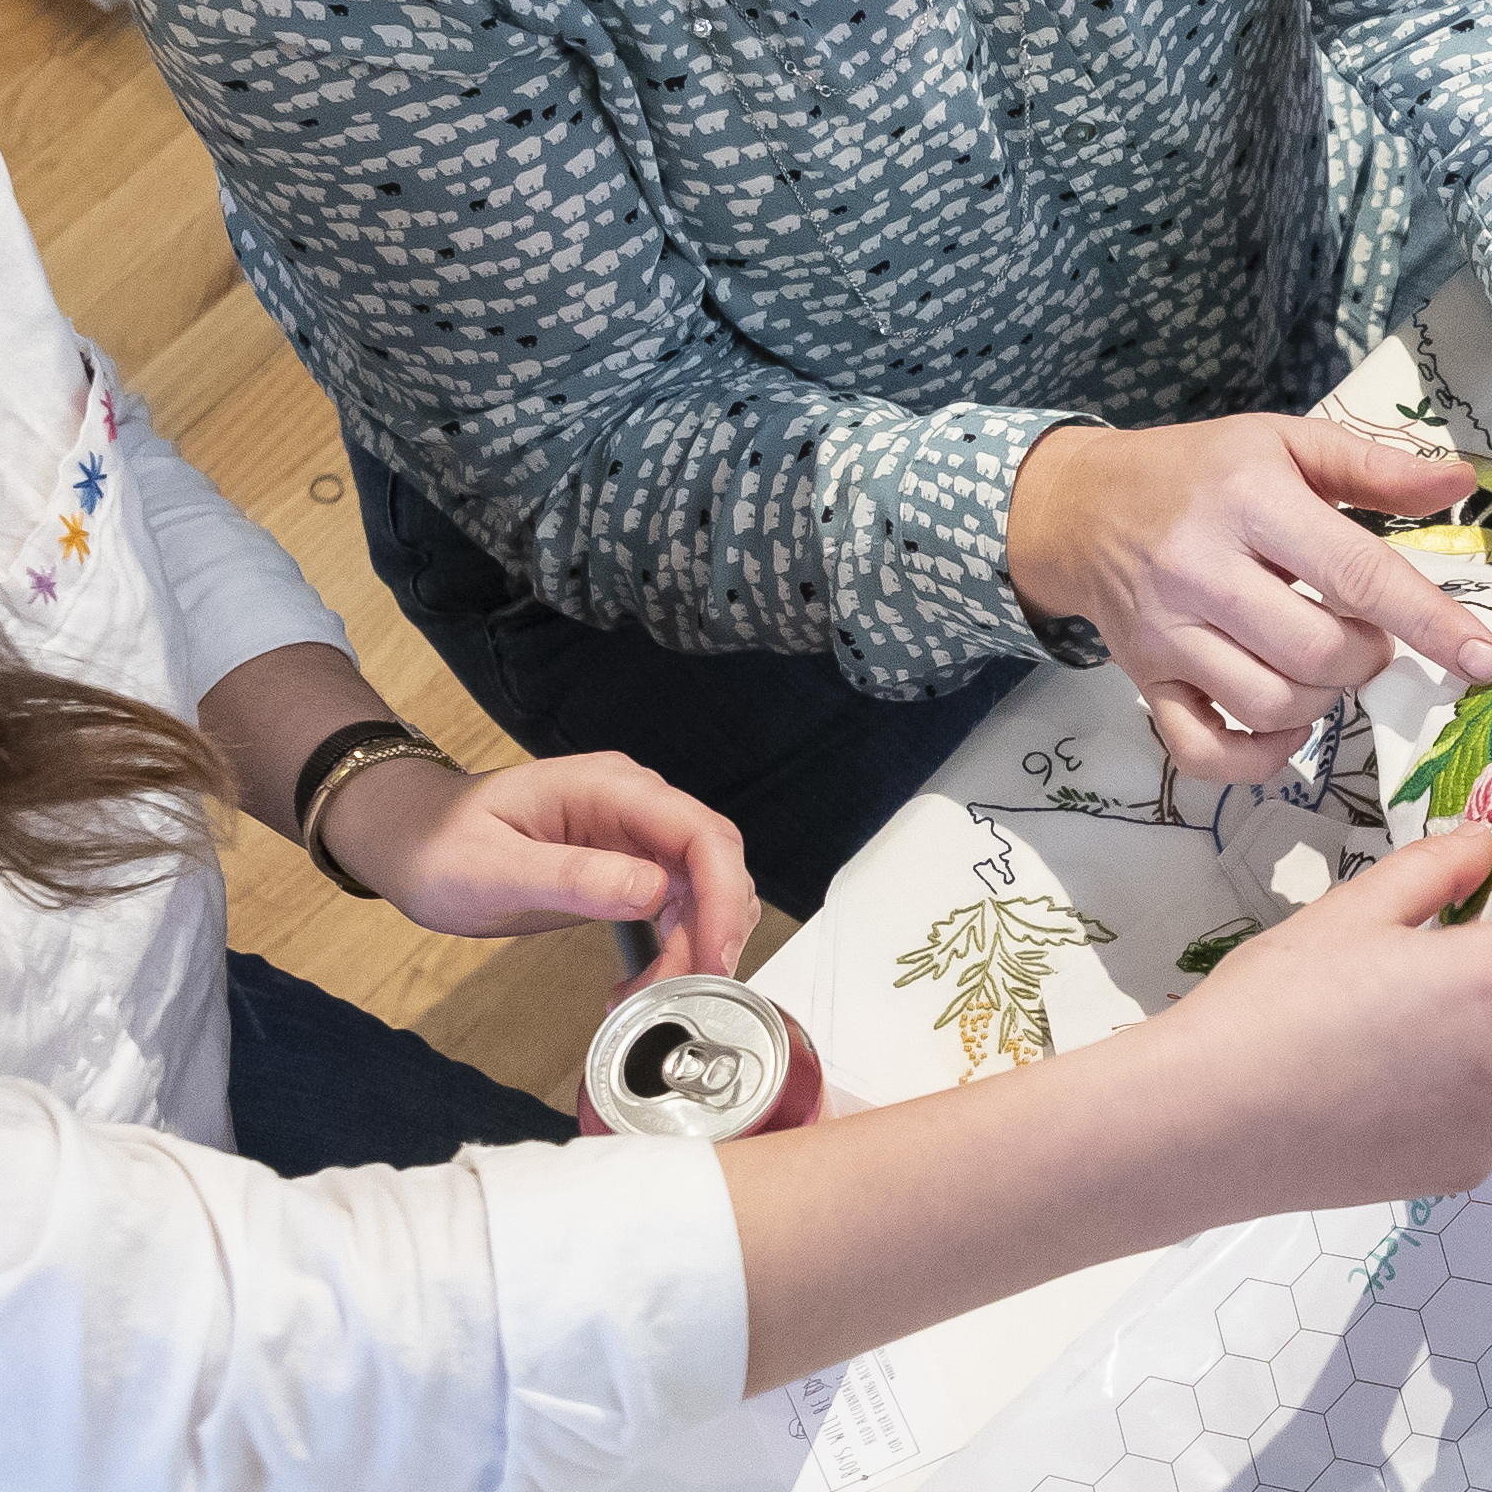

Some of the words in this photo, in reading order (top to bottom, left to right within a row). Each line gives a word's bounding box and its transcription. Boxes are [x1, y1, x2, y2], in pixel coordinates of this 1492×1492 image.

[1022, 737, 1083, 786] 36
[822, 1414, 844, 1446] WILL
[887, 1436, 904, 1454] FOR
[834, 1446, 861, 1479] BOYS
